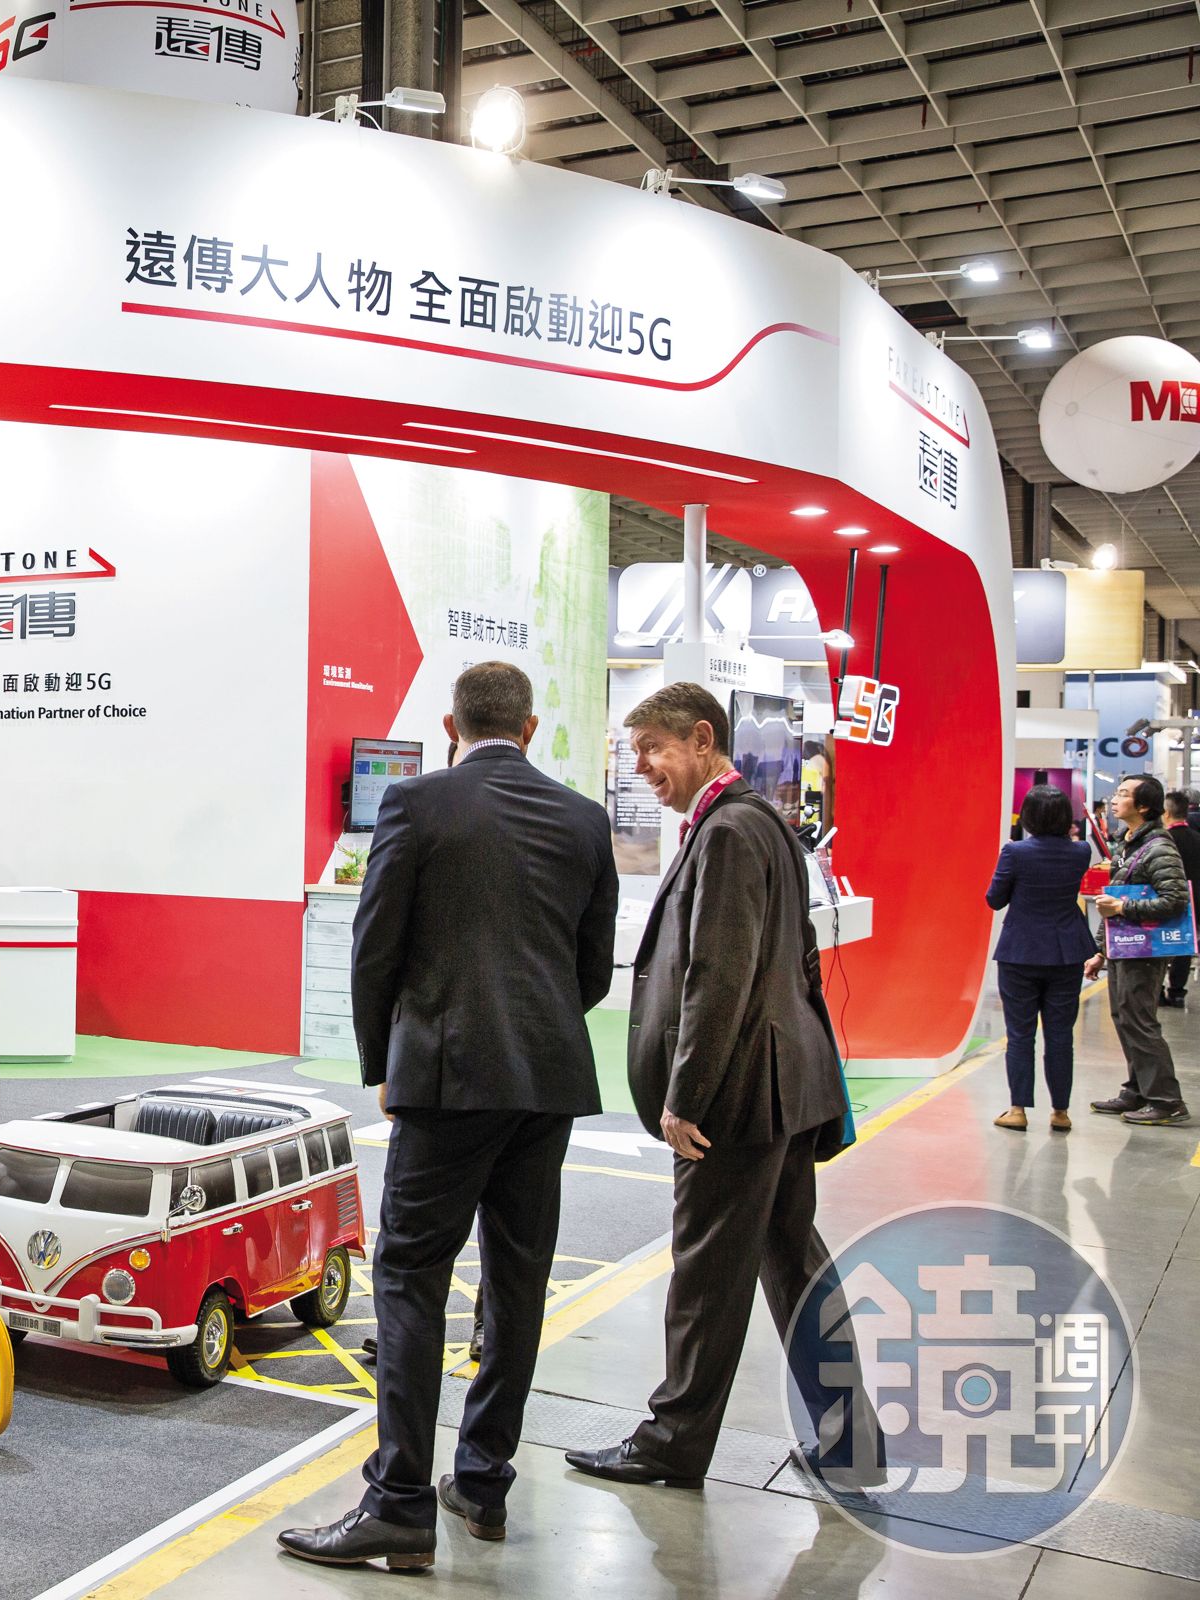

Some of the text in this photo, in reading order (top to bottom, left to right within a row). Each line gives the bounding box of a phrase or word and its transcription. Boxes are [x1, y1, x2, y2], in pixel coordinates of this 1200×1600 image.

[155, 16, 262, 71] 遠傳
[125, 227, 672, 361] 遠傳大人物 全面啟動迎5G
[448, 608, 528, 649] 智慧城市大願景
[38, 706, 85, 720] Partner
[87, 705, 101, 718] of
[103, 705, 147, 718] Choice
